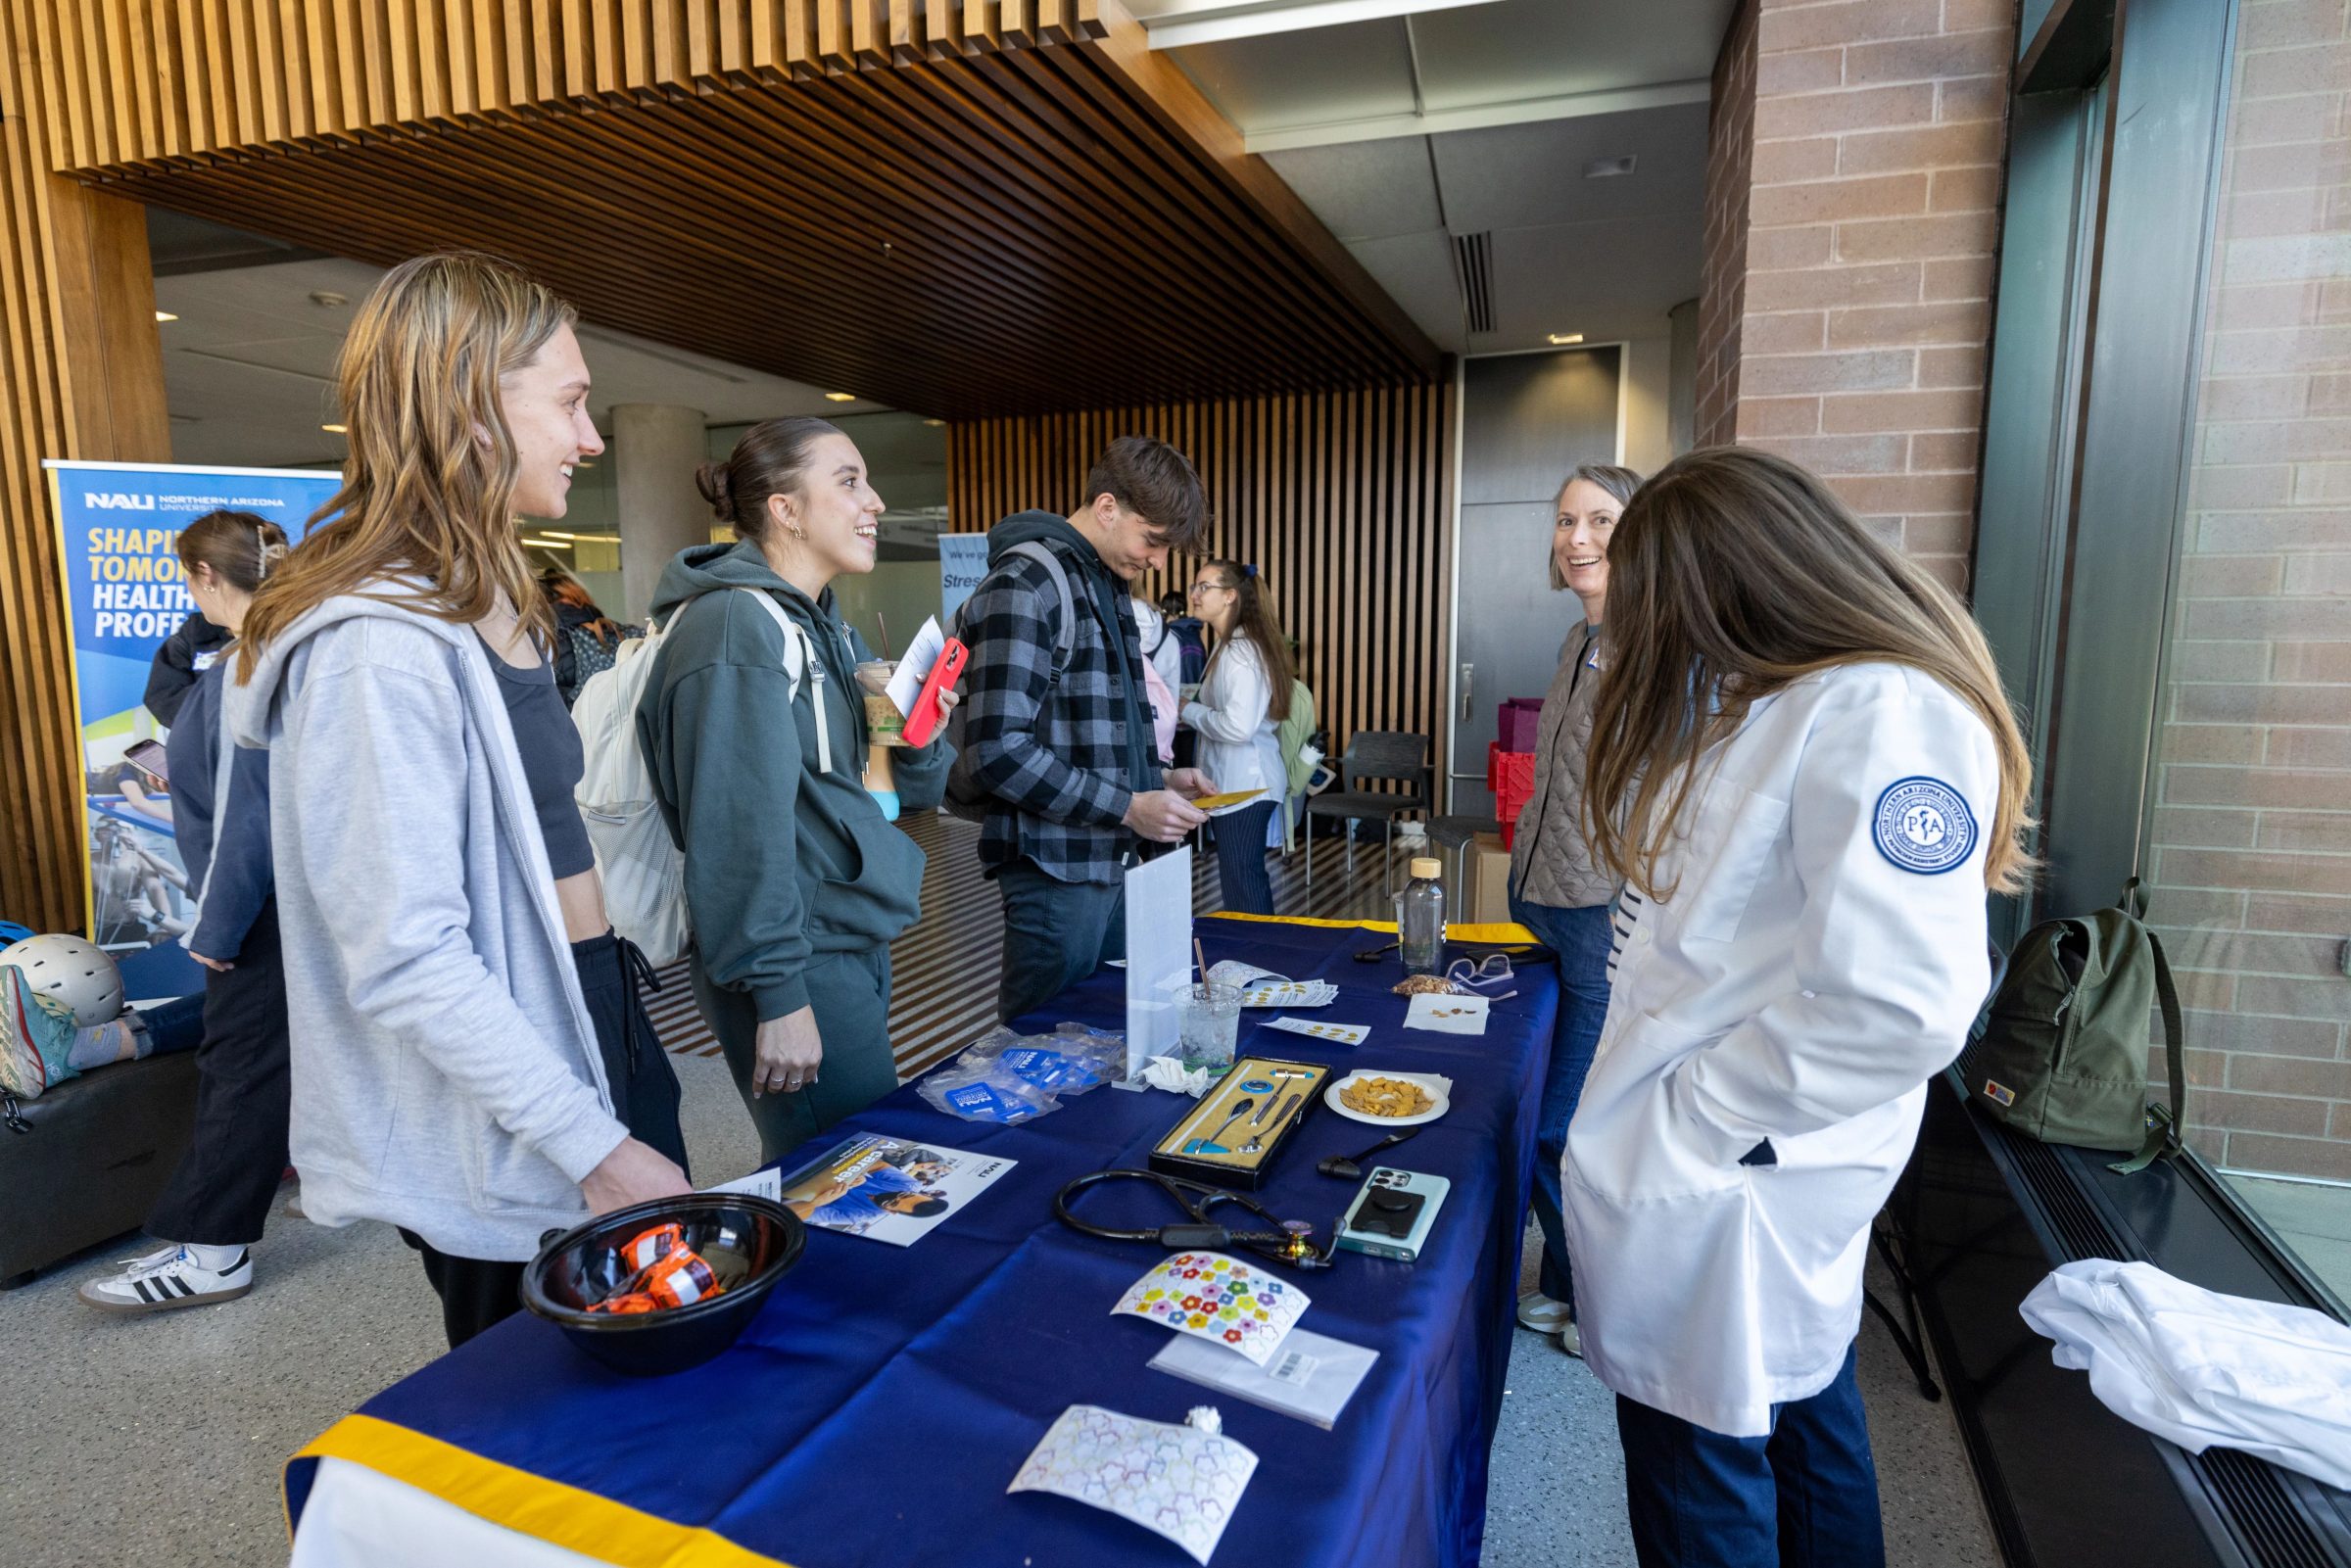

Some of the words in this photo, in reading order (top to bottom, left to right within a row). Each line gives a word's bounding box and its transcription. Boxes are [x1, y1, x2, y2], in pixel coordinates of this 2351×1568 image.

[84, 493, 155, 510] NAU
[159, 496, 228, 504] NORTHERN
[230, 498, 285, 506] ARIZONA
[93, 584, 195, 609] HEALTH
[95, 612, 188, 638] PROFE
[1883, 792, 1903, 835] NORTHERN
[1902, 786, 1941, 798] ARIZONA
[1942, 794, 1967, 840] UNIVERSITY
[958, 1096, 992, 1107] NAU
[834, 1151, 884, 1183] career
[978, 1162, 1002, 1178] NAU
